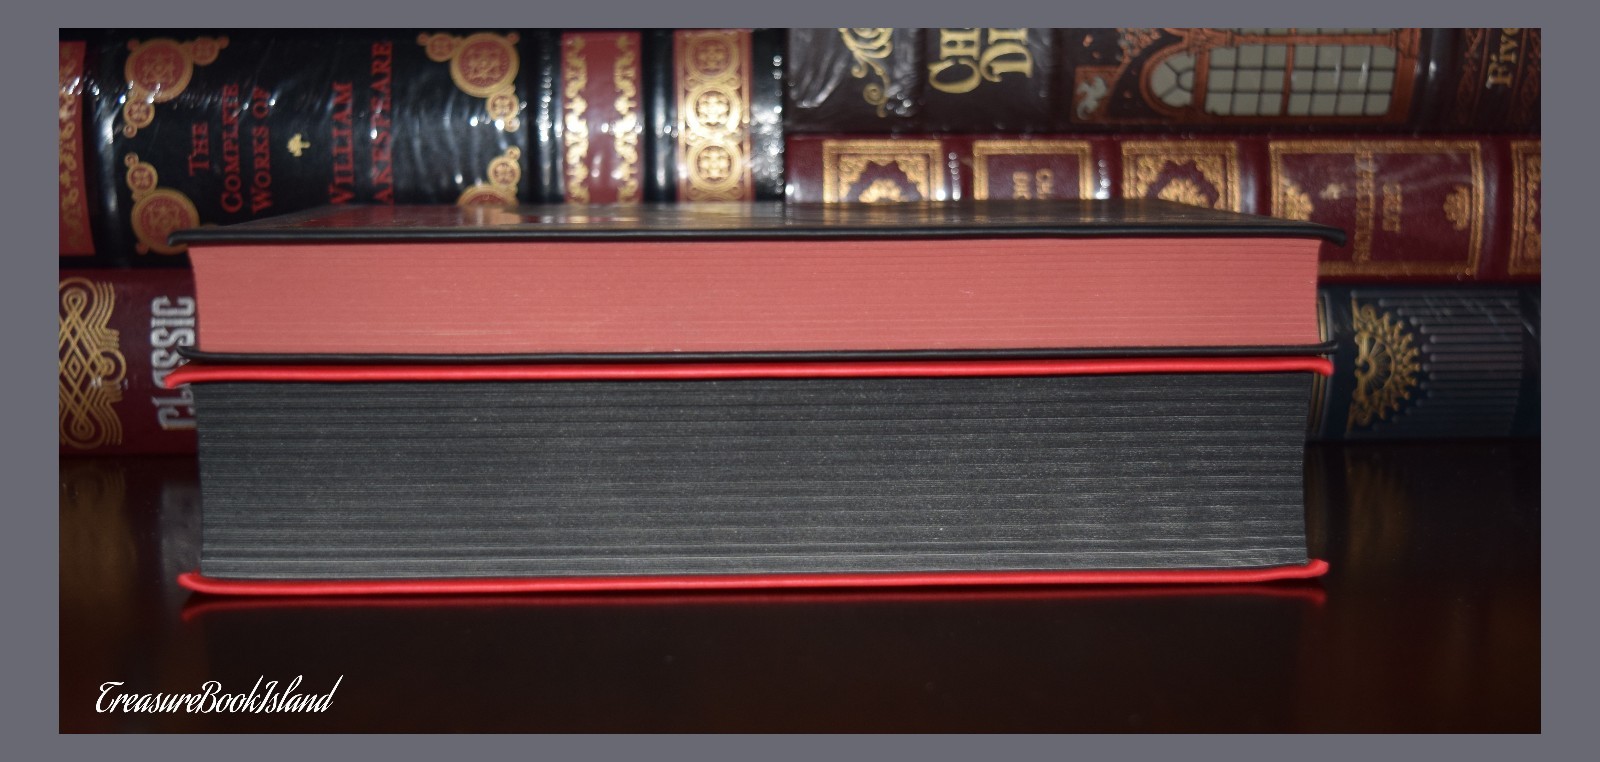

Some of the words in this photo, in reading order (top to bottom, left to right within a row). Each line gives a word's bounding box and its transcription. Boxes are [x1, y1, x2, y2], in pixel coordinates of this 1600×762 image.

[252, 84, 272, 119] OF
[188, 121, 210, 177] THE
[221, 82, 243, 213] COMPLETE
[251, 125, 273, 214] WORKS
